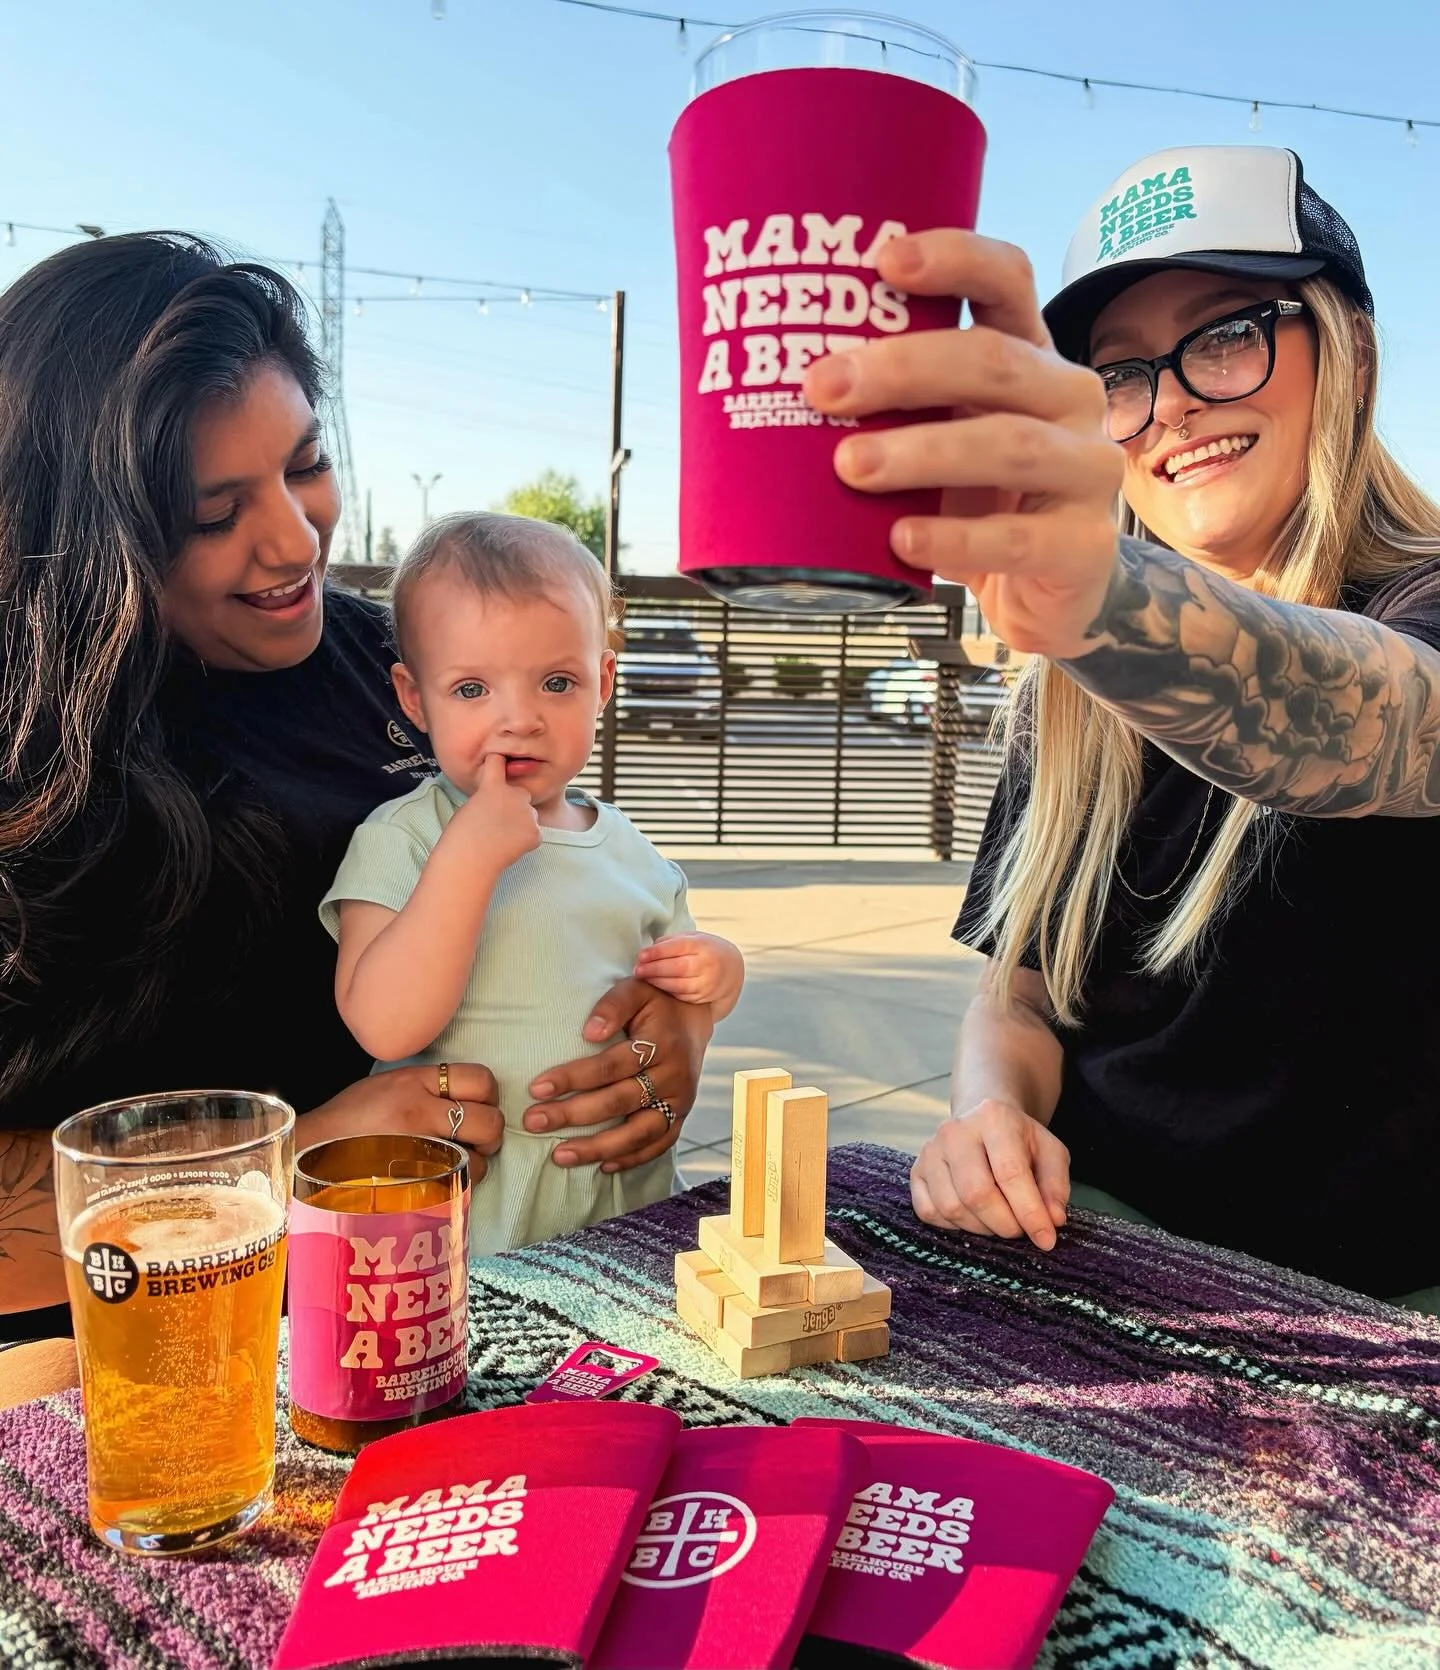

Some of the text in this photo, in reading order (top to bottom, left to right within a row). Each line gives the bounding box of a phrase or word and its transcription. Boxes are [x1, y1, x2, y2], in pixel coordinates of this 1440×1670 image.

[1100, 167, 1192, 223] MAMA
[1096, 203, 1198, 263] A BEER
[1100, 186, 1195, 244] NEEDS
[703, 273, 909, 336] NEEDS
[698, 340, 732, 394] A
[730, 410, 823, 429] BREWING
[90, 1251, 125, 1270] B H
[146, 1219, 288, 1277] BARRELHOUSE
[92, 1275, 126, 1294] B C
[147, 1260, 255, 1297] BREWING
[340, 1330, 384, 1369] A
[384, 1370, 452, 1401] BREWING
[555, 1372, 607, 1391] NEEDS
[560, 1381, 600, 1397] BEER
[563, 1367, 612, 1385] MAMA
[358, 1474, 528, 1527] MAMA
[854, 1482, 975, 1521] AMA
[343, 1501, 524, 1556] NEEDS
[645, 1509, 732, 1532] B H
[846, 1502, 971, 1545] EEDS
[323, 1528, 519, 1588] A BEER
[629, 1545, 717, 1569] B C
[835, 1525, 964, 1574] BEER
[352, 1559, 479, 1592] BARRELHOUSE
